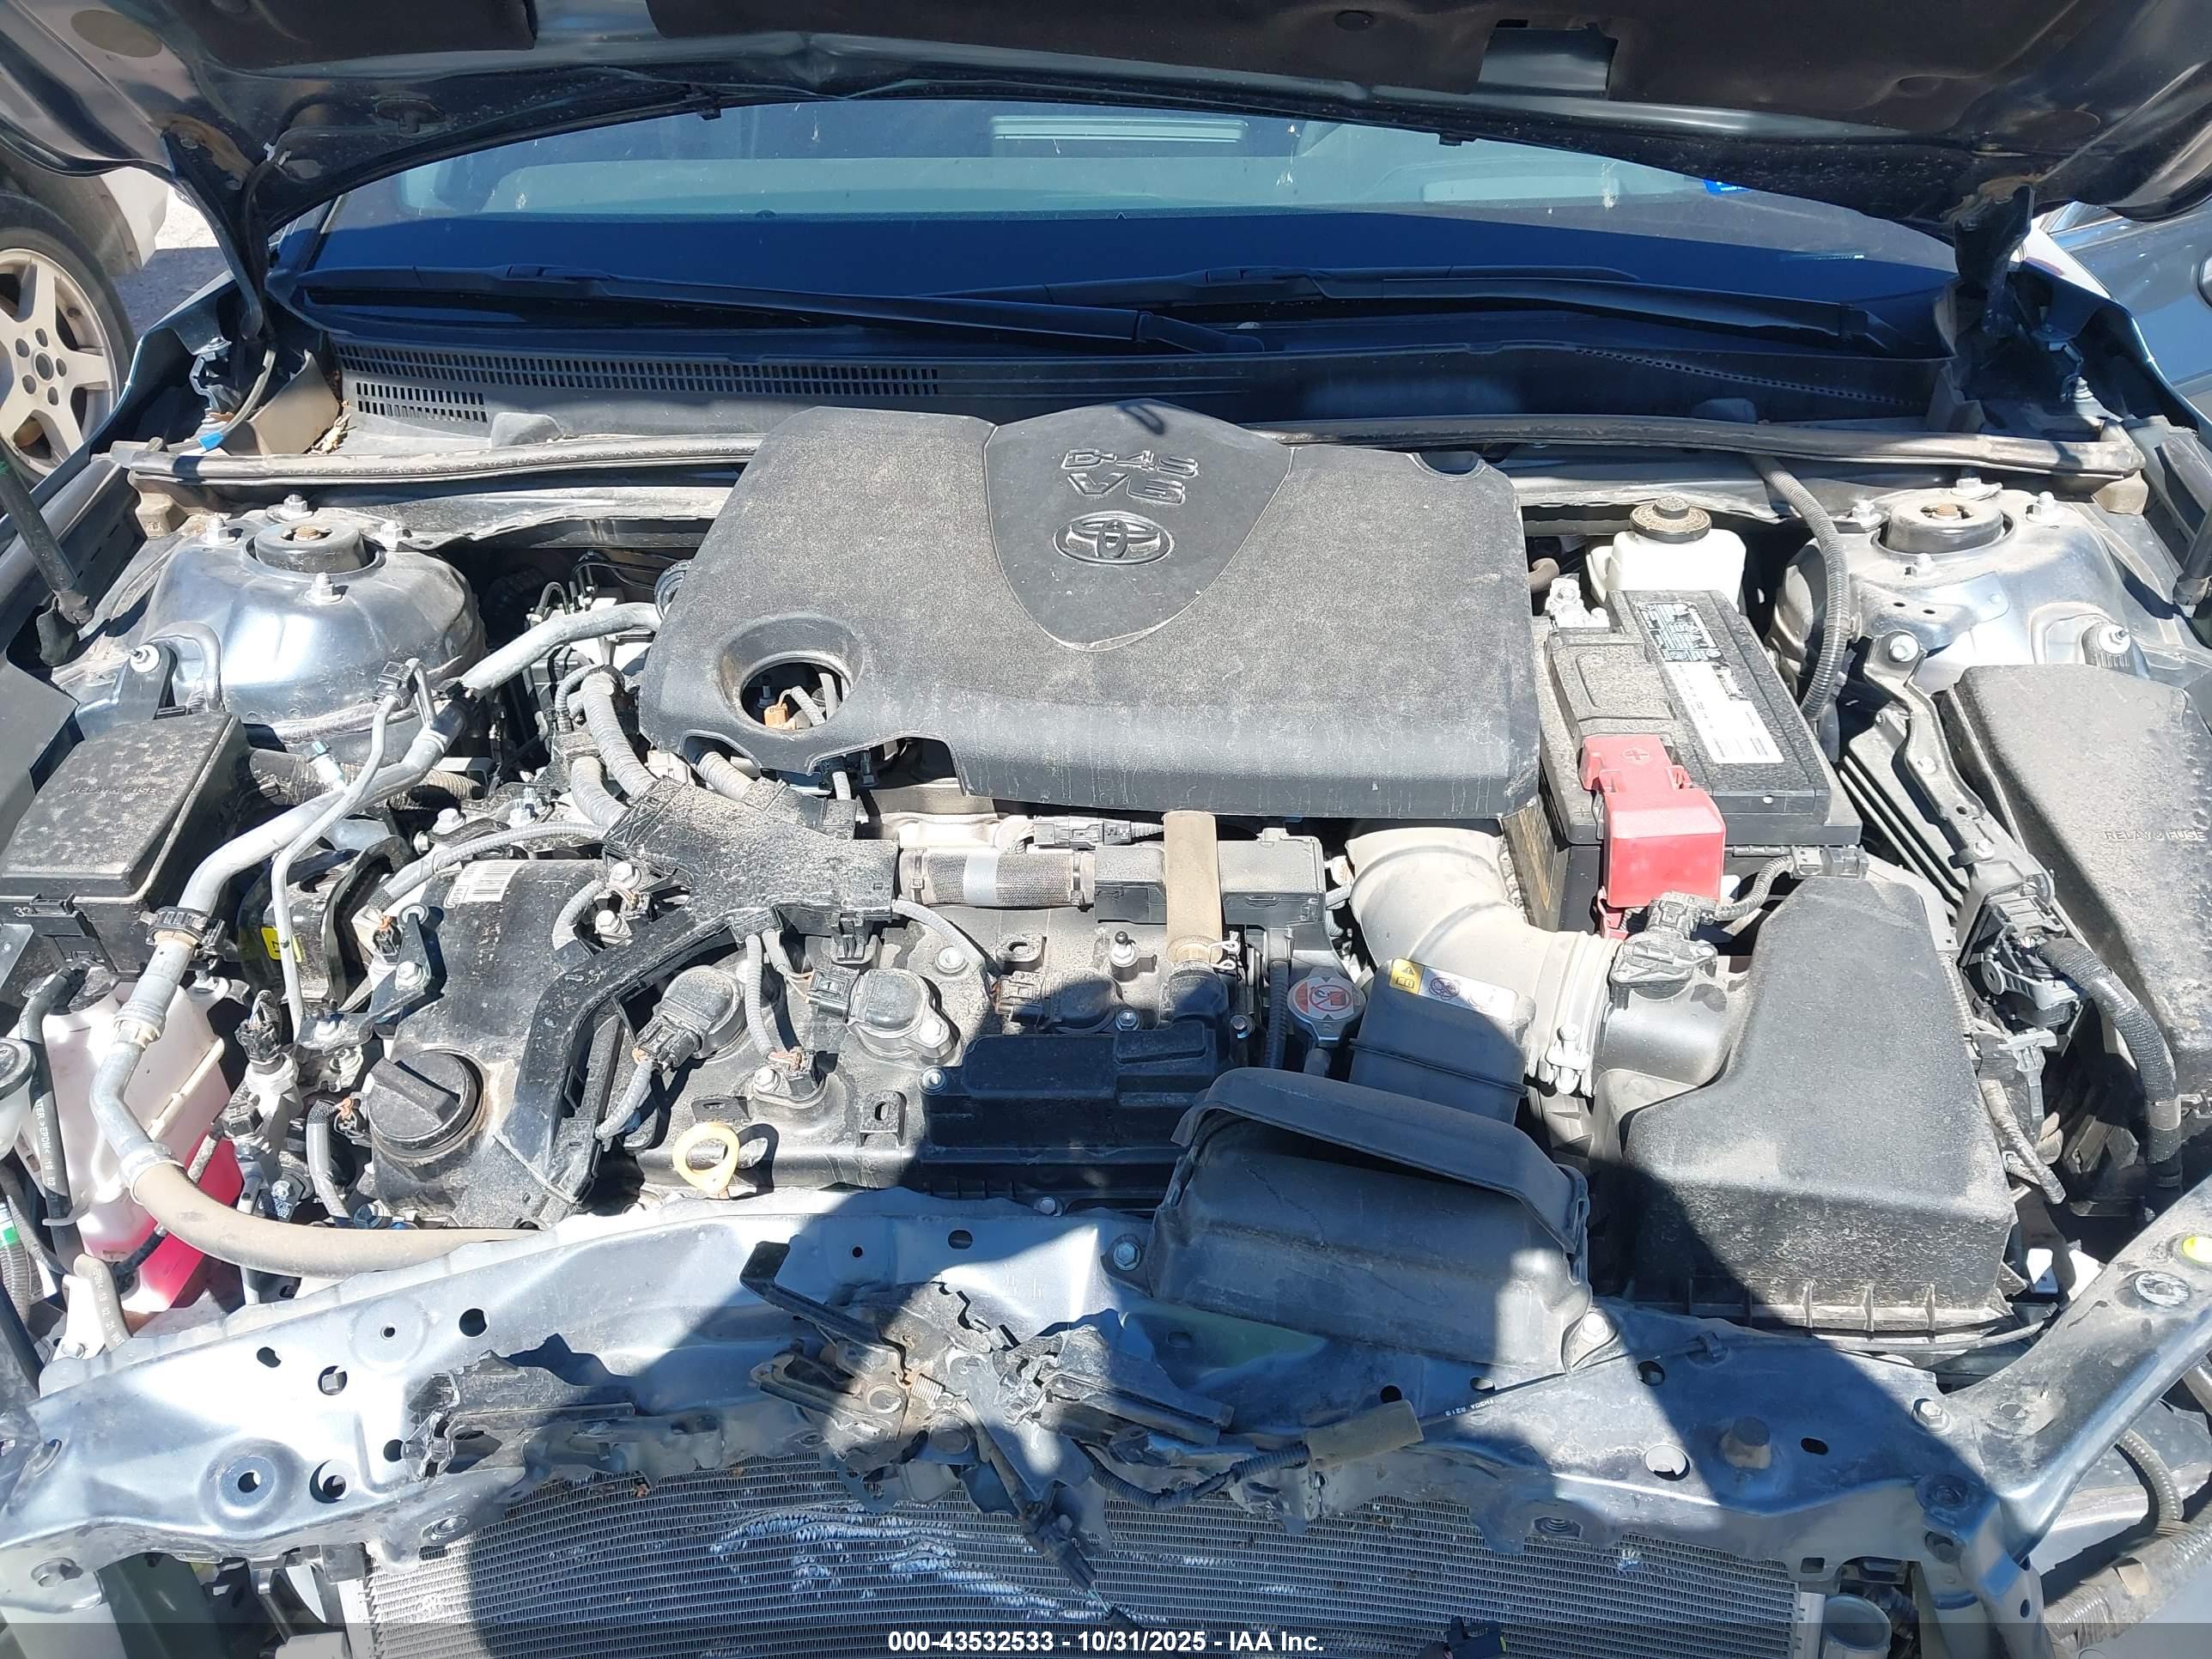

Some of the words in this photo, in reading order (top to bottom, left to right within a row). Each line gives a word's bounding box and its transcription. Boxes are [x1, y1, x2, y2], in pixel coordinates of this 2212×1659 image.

[1060, 447, 1199, 479] D-4S
[1066, 471, 1187, 506] V6
[123, 786, 157, 794] FUSE
[2103, 830, 2152, 841] RELAY
[2154, 830, 2165, 841] &
[2166, 830, 2209, 842] FUSE
